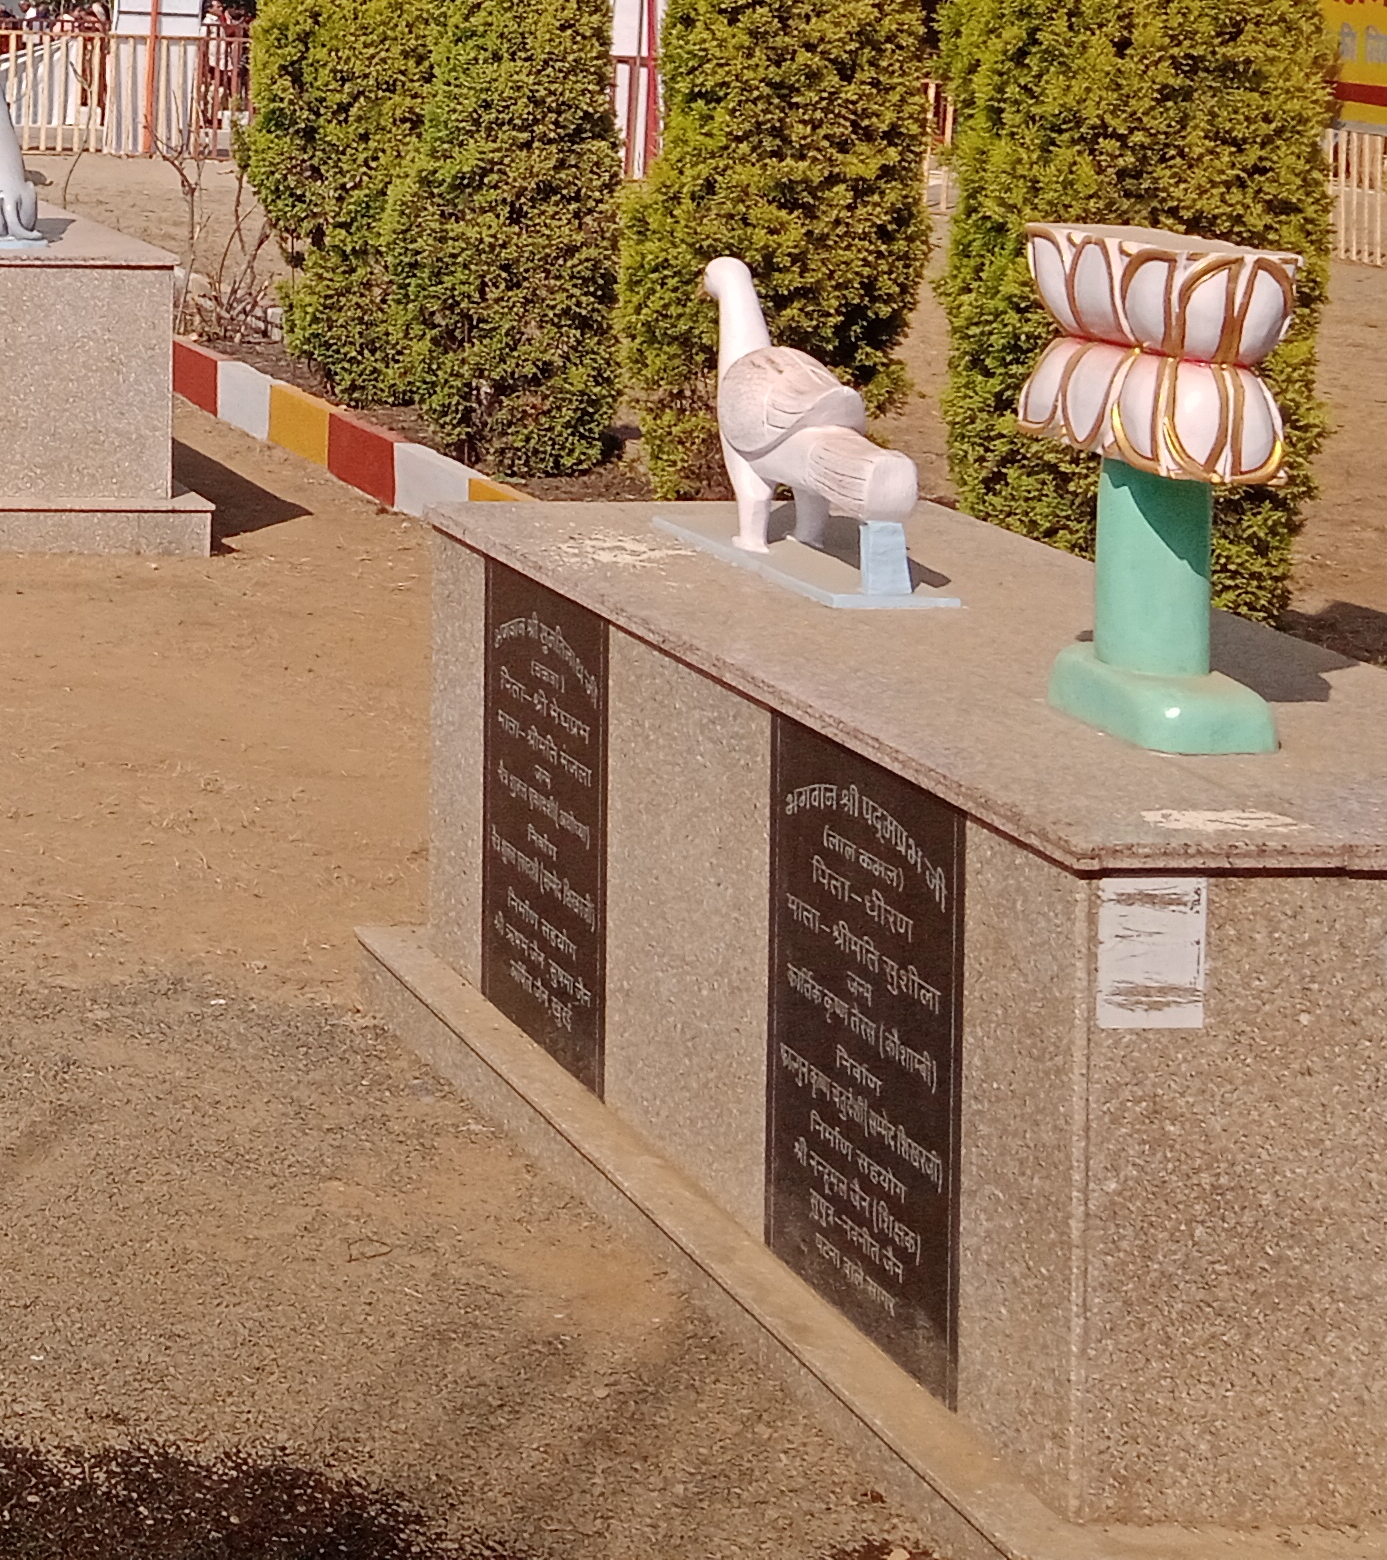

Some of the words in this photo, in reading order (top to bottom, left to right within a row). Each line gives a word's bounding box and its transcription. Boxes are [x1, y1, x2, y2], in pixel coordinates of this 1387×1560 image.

[785, 783, 838, 815] भगवान
[839, 784, 858, 817] श्री
[924, 857, 946, 913] जी
[846, 970, 872, 1007] जन्म
[881, 955, 941, 1014] सुशीला
[836, 1043, 882, 1096] निर्वाण
[793, 1136, 807, 1166] श्री
[849, 1178, 869, 1216] जैन
[810, 1109, 852, 1161] निर्माण
[855, 1149, 907, 1203] सहयोग
[882, 1246, 903, 1283] जैन
